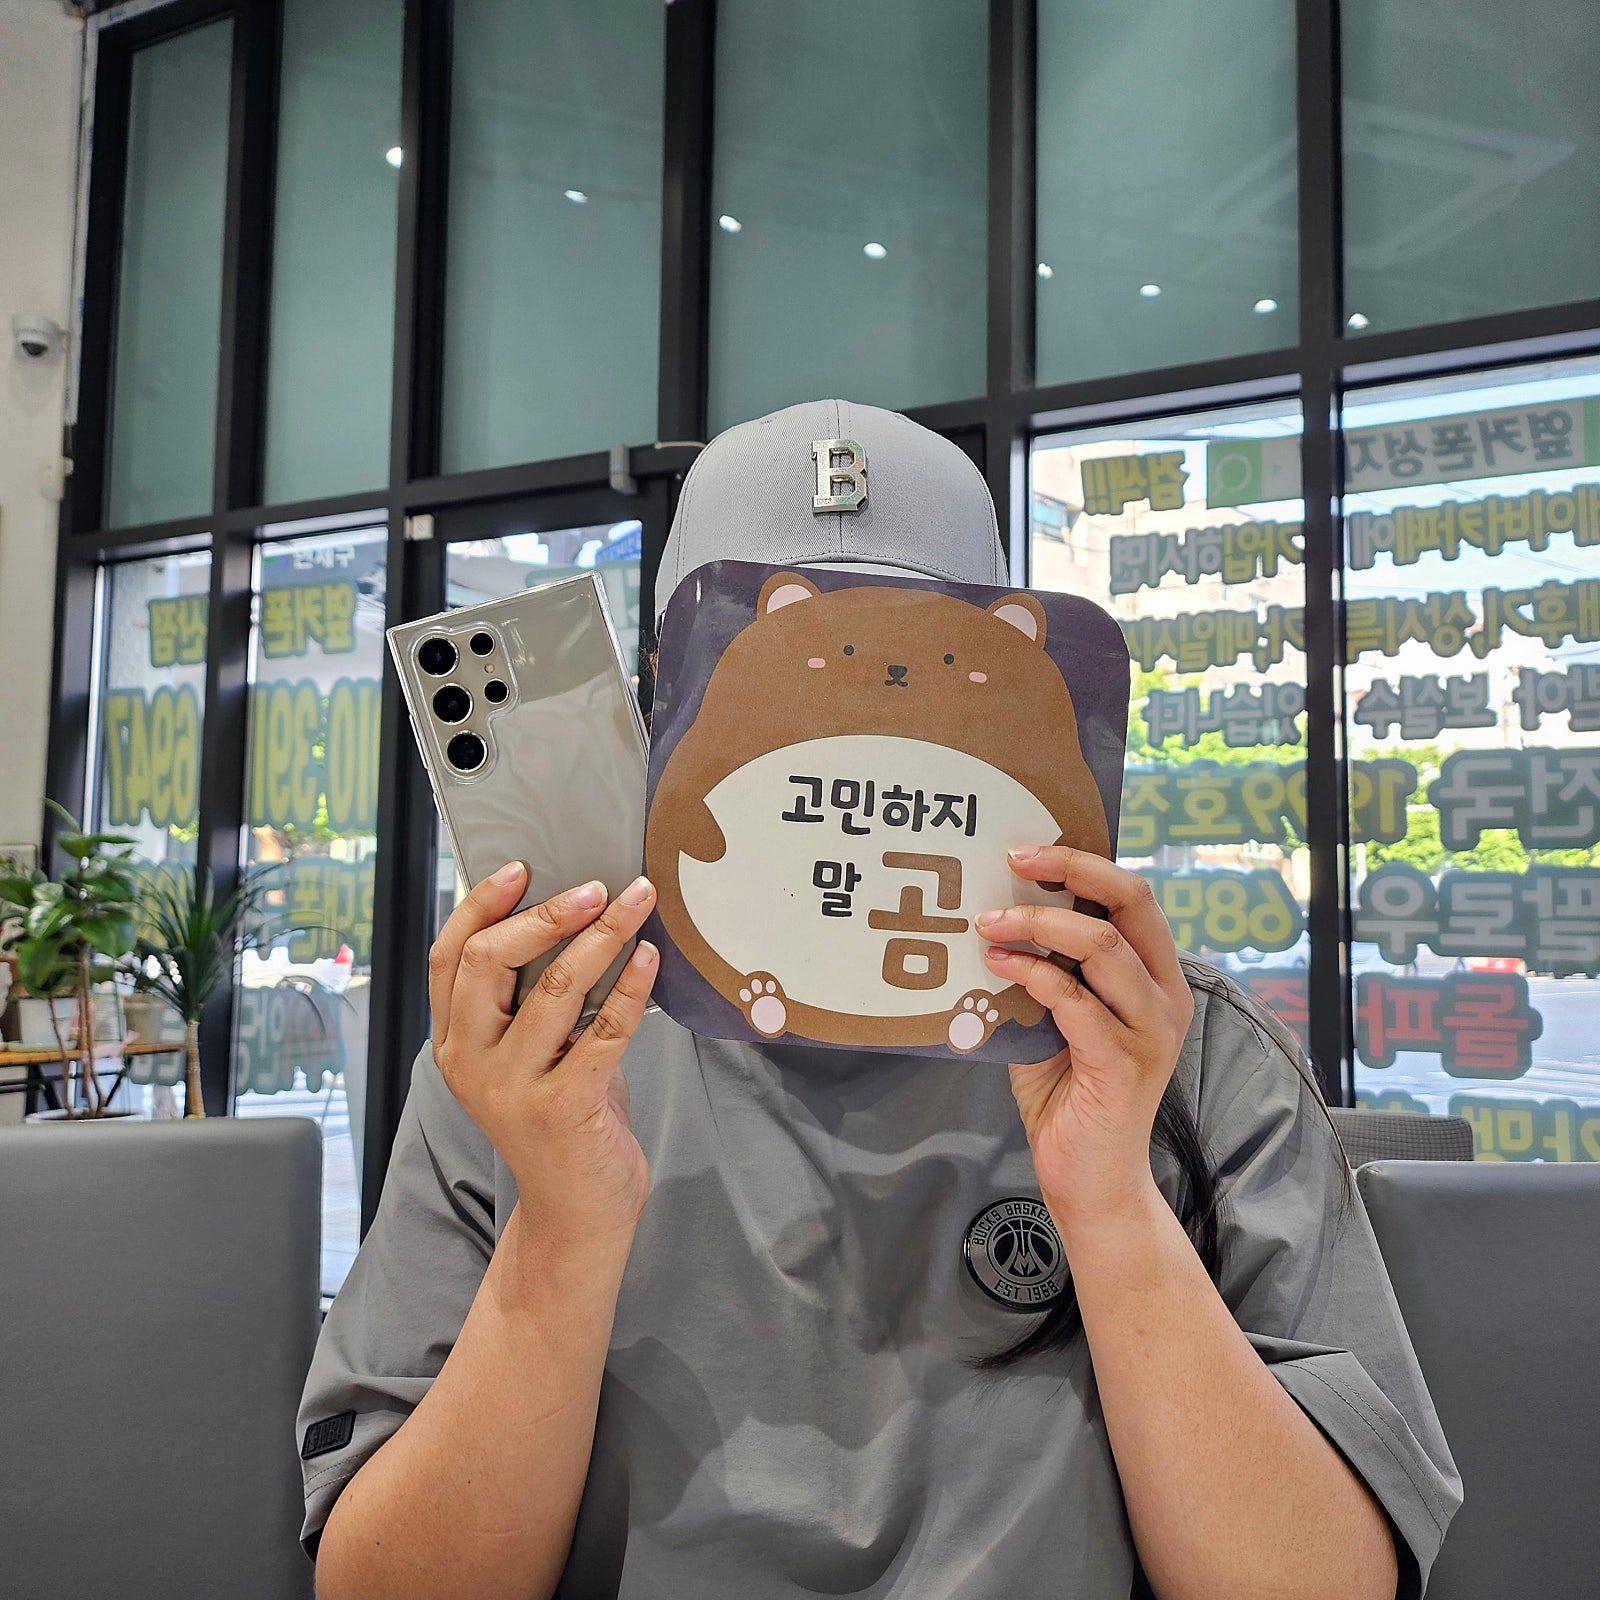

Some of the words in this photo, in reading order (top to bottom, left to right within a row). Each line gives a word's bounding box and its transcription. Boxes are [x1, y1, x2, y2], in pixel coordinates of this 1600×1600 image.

[811, 439, 867, 513] B
[782, 775, 977, 837] 고민하지
[972, 1209, 1002, 1246] BUCKS
[994, 1280, 1023, 1301] EST.
[1028, 1279, 1060, 1302] 1968
